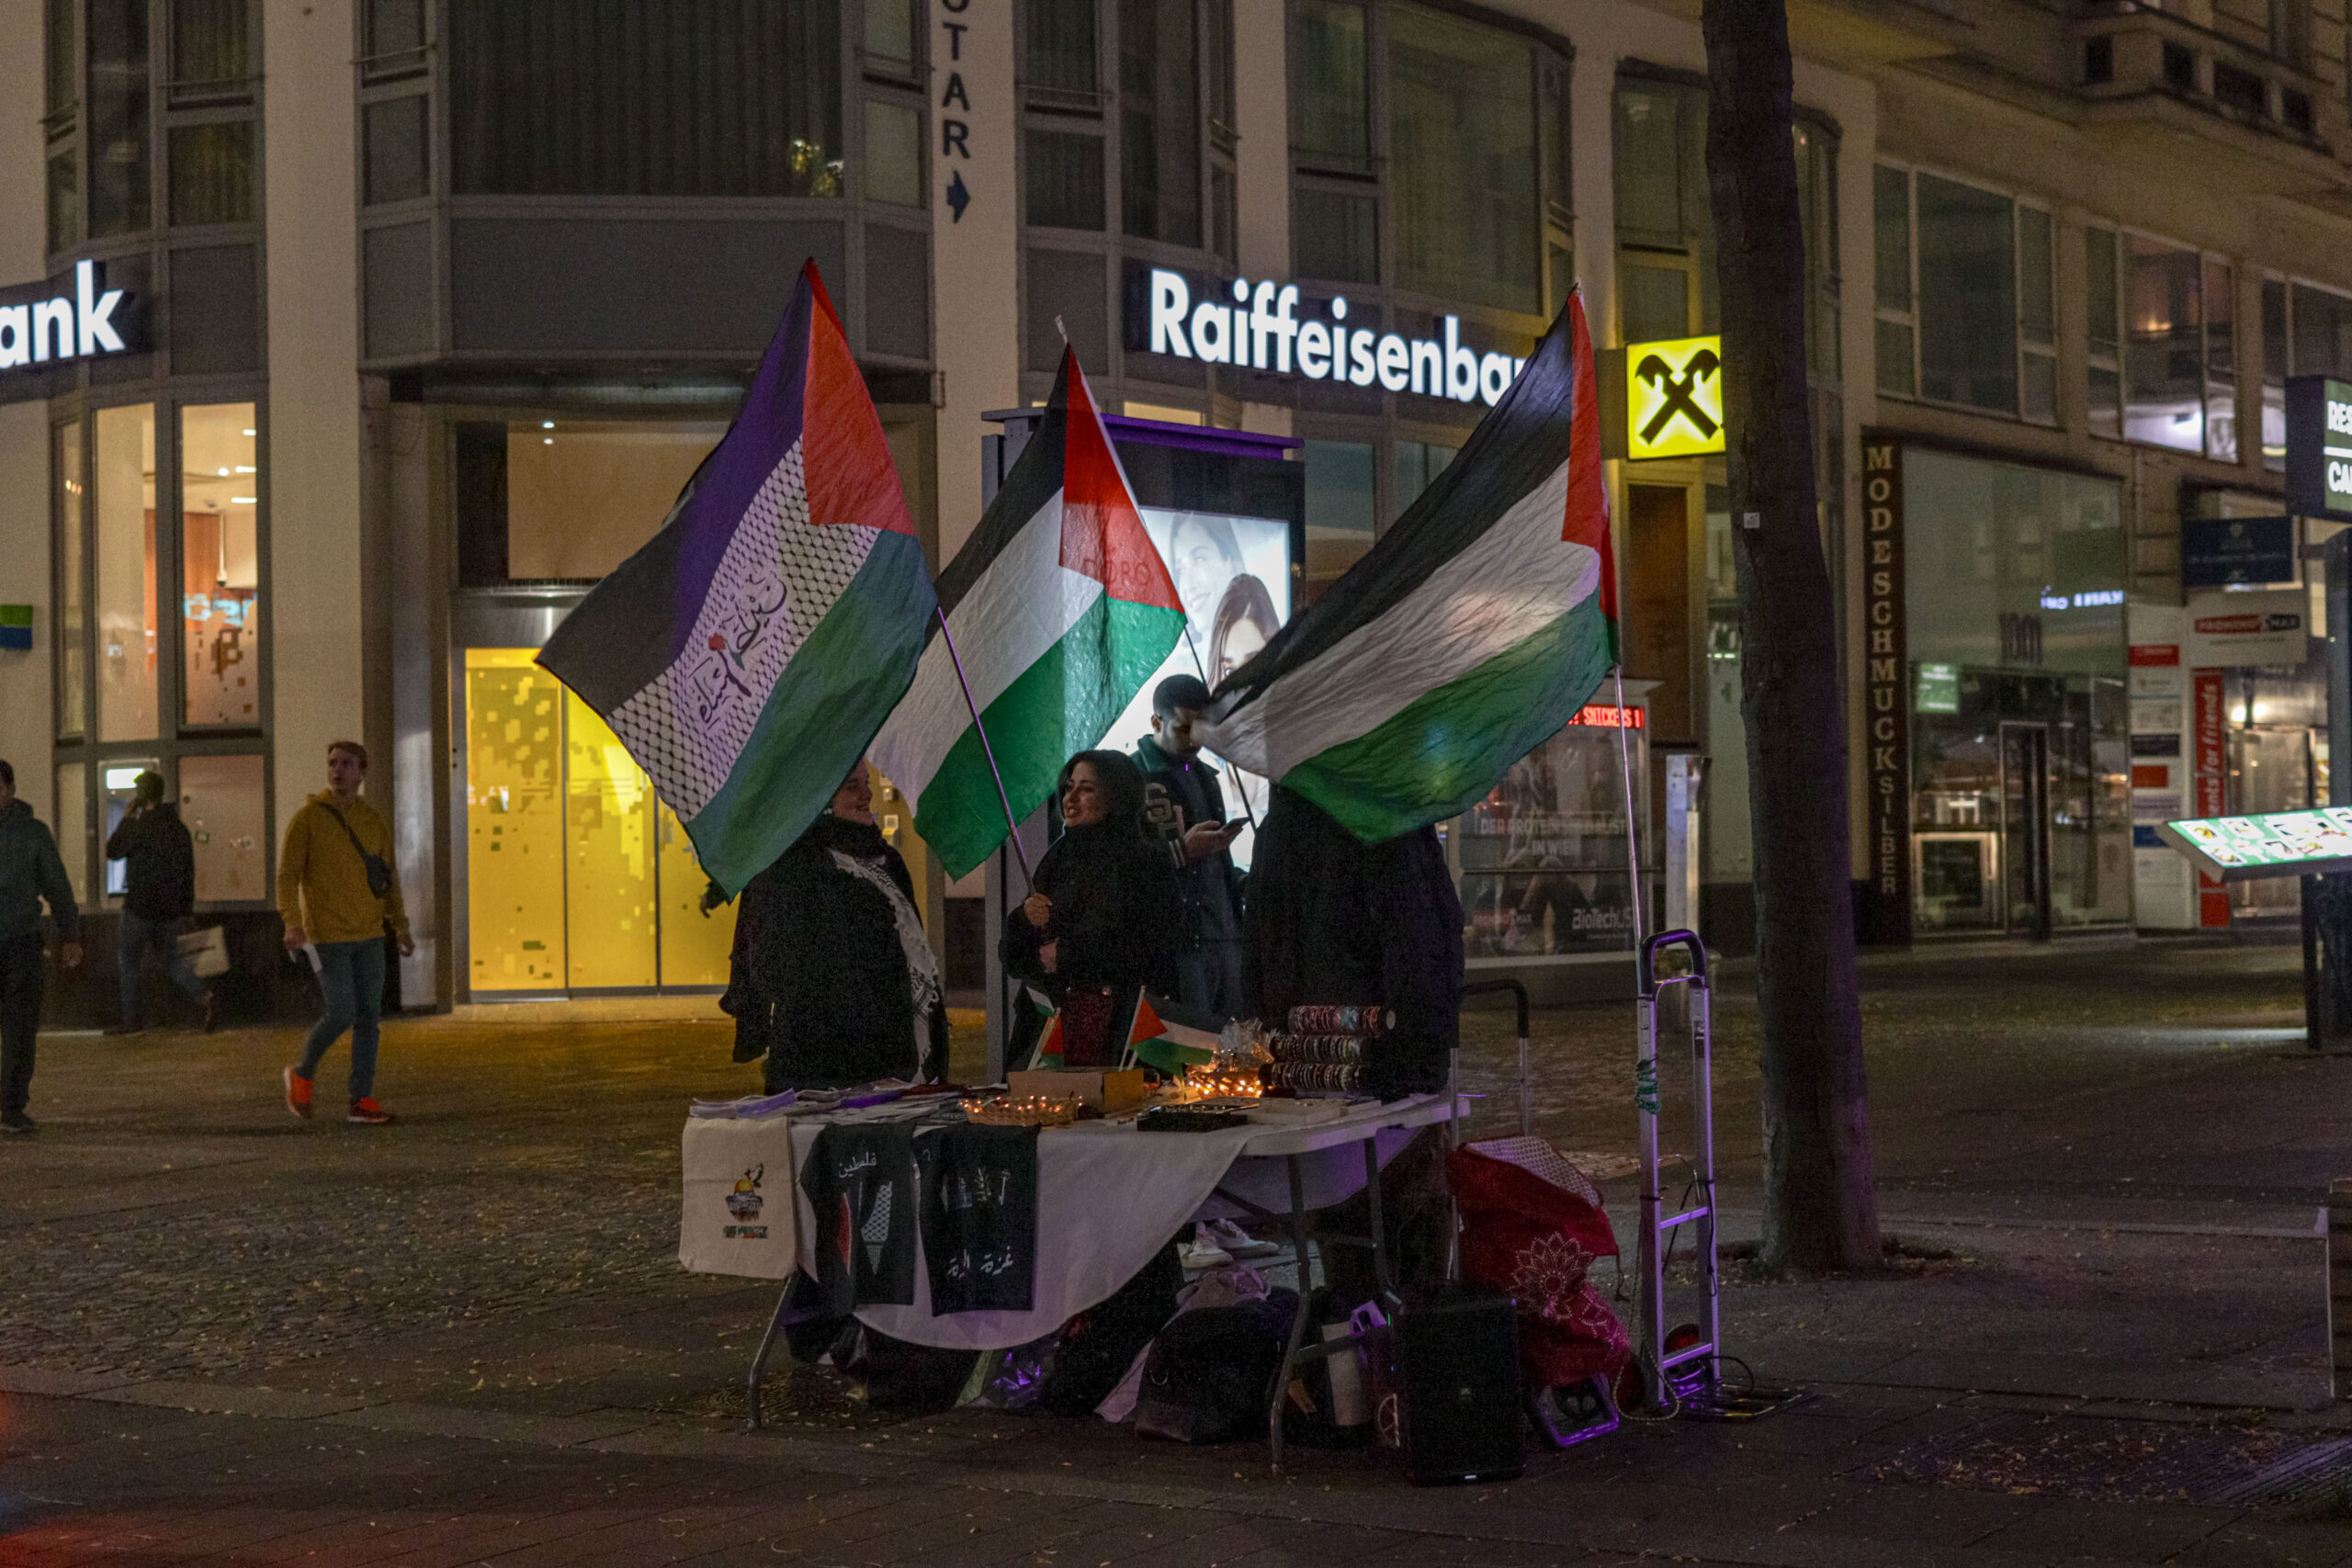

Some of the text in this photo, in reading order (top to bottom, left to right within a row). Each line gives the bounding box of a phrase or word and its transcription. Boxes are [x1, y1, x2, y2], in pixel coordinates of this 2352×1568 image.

[0, 259, 126, 368] ank
[1151, 269, 1527, 407] Raiffeisenba
[2327, 454, 2352, 495] CA
[1867, 446, 1897, 895] MODESCHMUCK SILBER
[1582, 706, 1632, 728] SNICKES
[2201, 683, 2218, 745] friends
[1481, 818, 1505, 835] DER
[1532, 840, 1545, 856] IN
[1572, 906, 1634, 930] BioTechUS
[838, 1151, 876, 1179] فلسطين
[979, 1245, 1014, 1277] غزة
